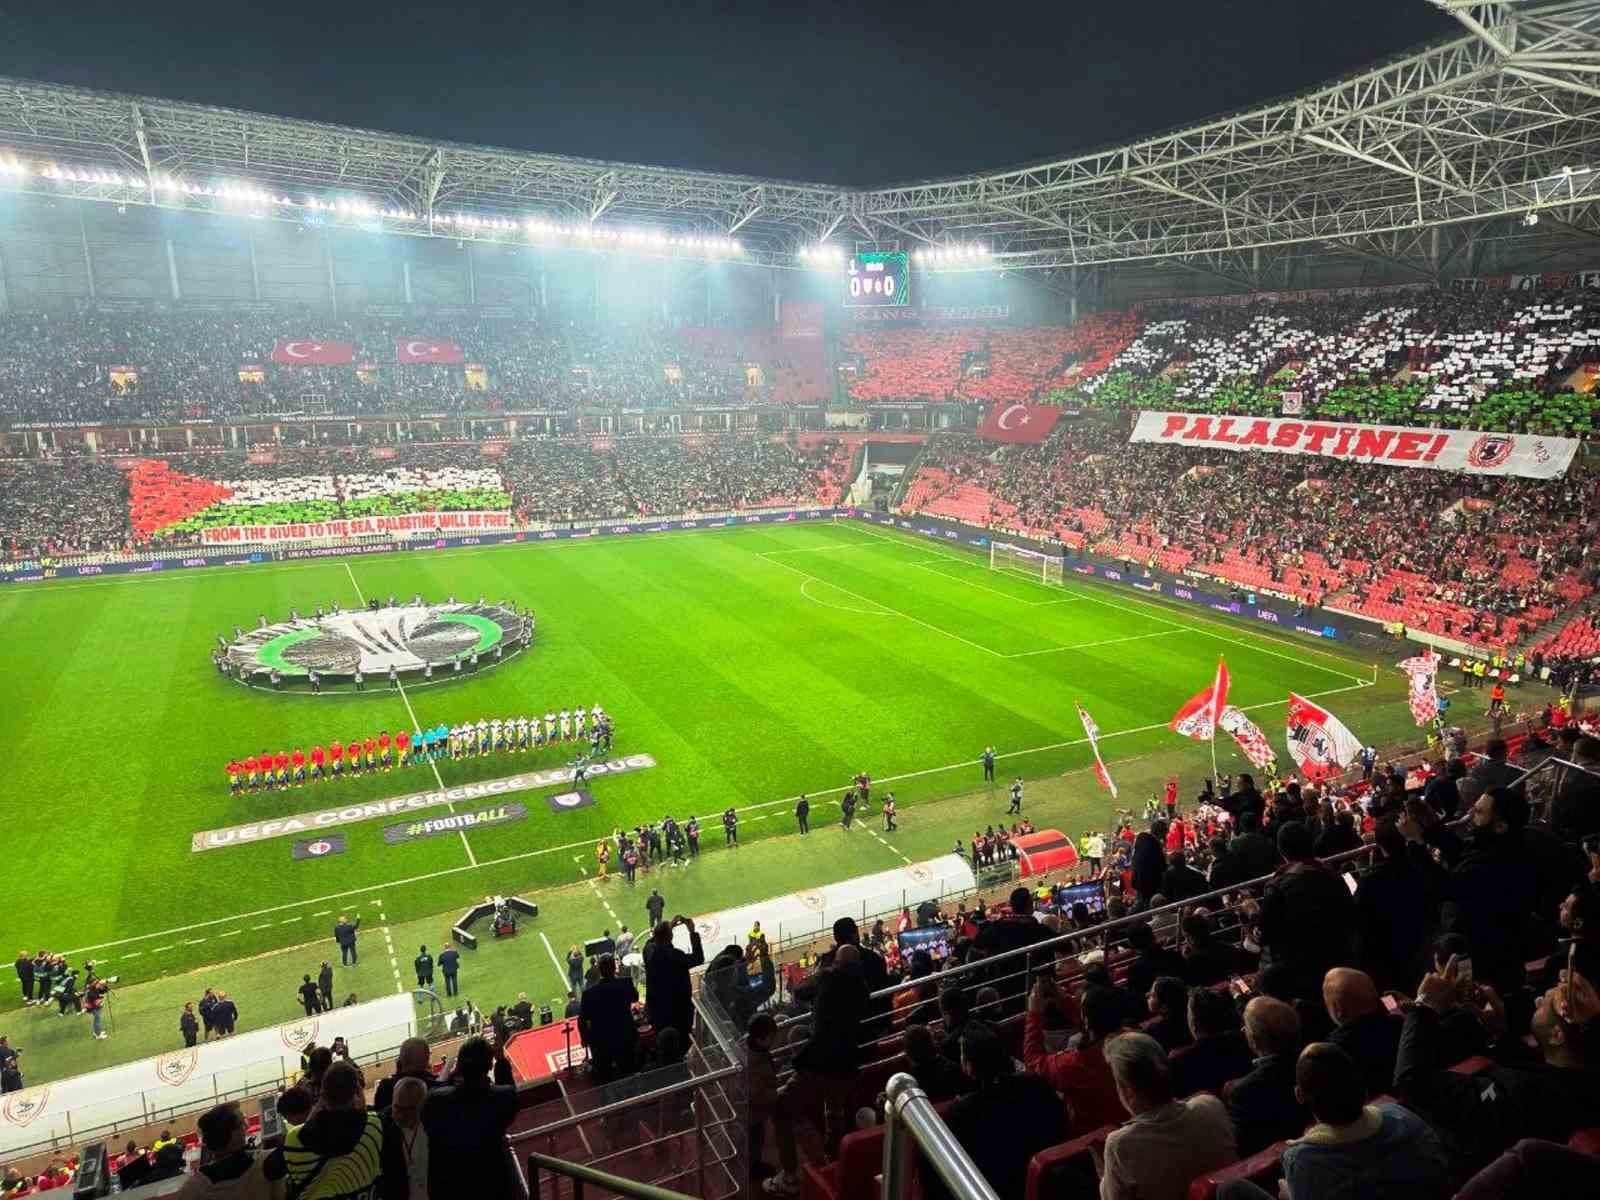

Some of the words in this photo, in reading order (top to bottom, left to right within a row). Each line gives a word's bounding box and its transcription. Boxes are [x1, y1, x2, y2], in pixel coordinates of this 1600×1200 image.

[851, 277, 860, 297] 0
[884, 275, 894, 296] 0
[204, 527, 241, 542] FROM
[244, 527, 267, 540] THE
[269, 523, 306, 539] RIVER
[308, 523, 324, 537] TO
[326, 521, 348, 537] THE
[351, 518, 376, 534] SEA,
[377, 515, 436, 531] PALESTINE
[438, 513, 466, 528] WILL
[468, 514, 482, 527] BE
[483, 514, 509, 527] FREE
[78, 566, 103, 574] UEFA
[183, 558, 208, 567] UEFA
[1257, 609, 1279, 623] UEFA
[208, 819, 305, 843] UEFA
[314, 778, 524, 824] CONFERENCE
[406, 806, 511, 836] #FOOTBALL
